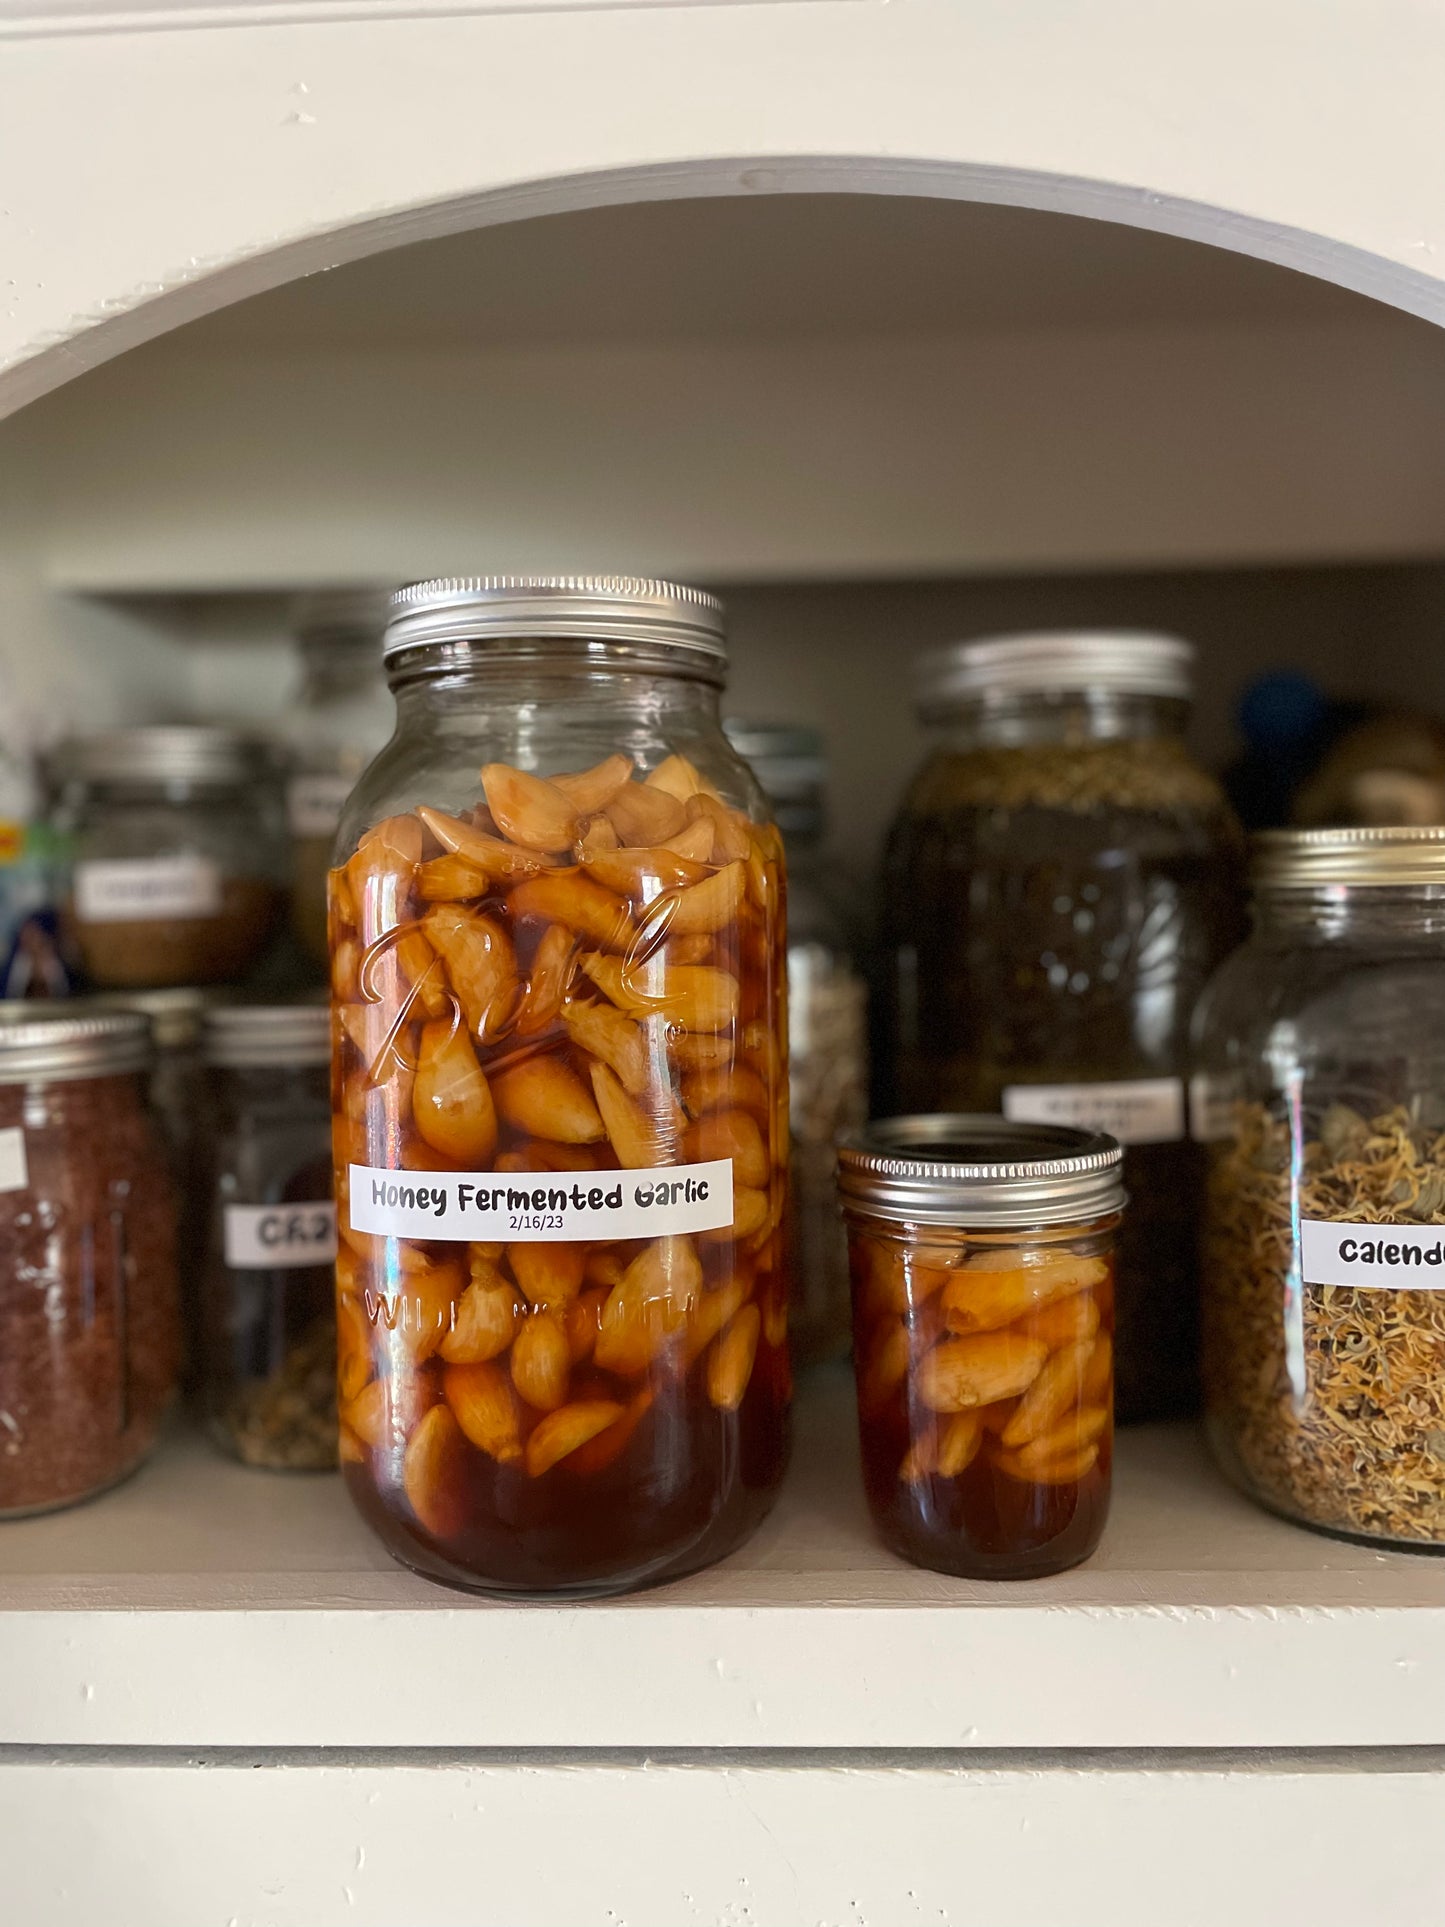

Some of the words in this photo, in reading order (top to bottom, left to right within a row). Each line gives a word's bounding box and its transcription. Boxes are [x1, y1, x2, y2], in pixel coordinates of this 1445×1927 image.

[372, 1179, 447, 1217] Honey
[457, 1183, 623, 1212] Fermented
[634, 1177, 709, 1208] Garlic
[509, 1214, 564, 1232] 2/16/23
[1338, 1238, 1445, 1266] Calend
